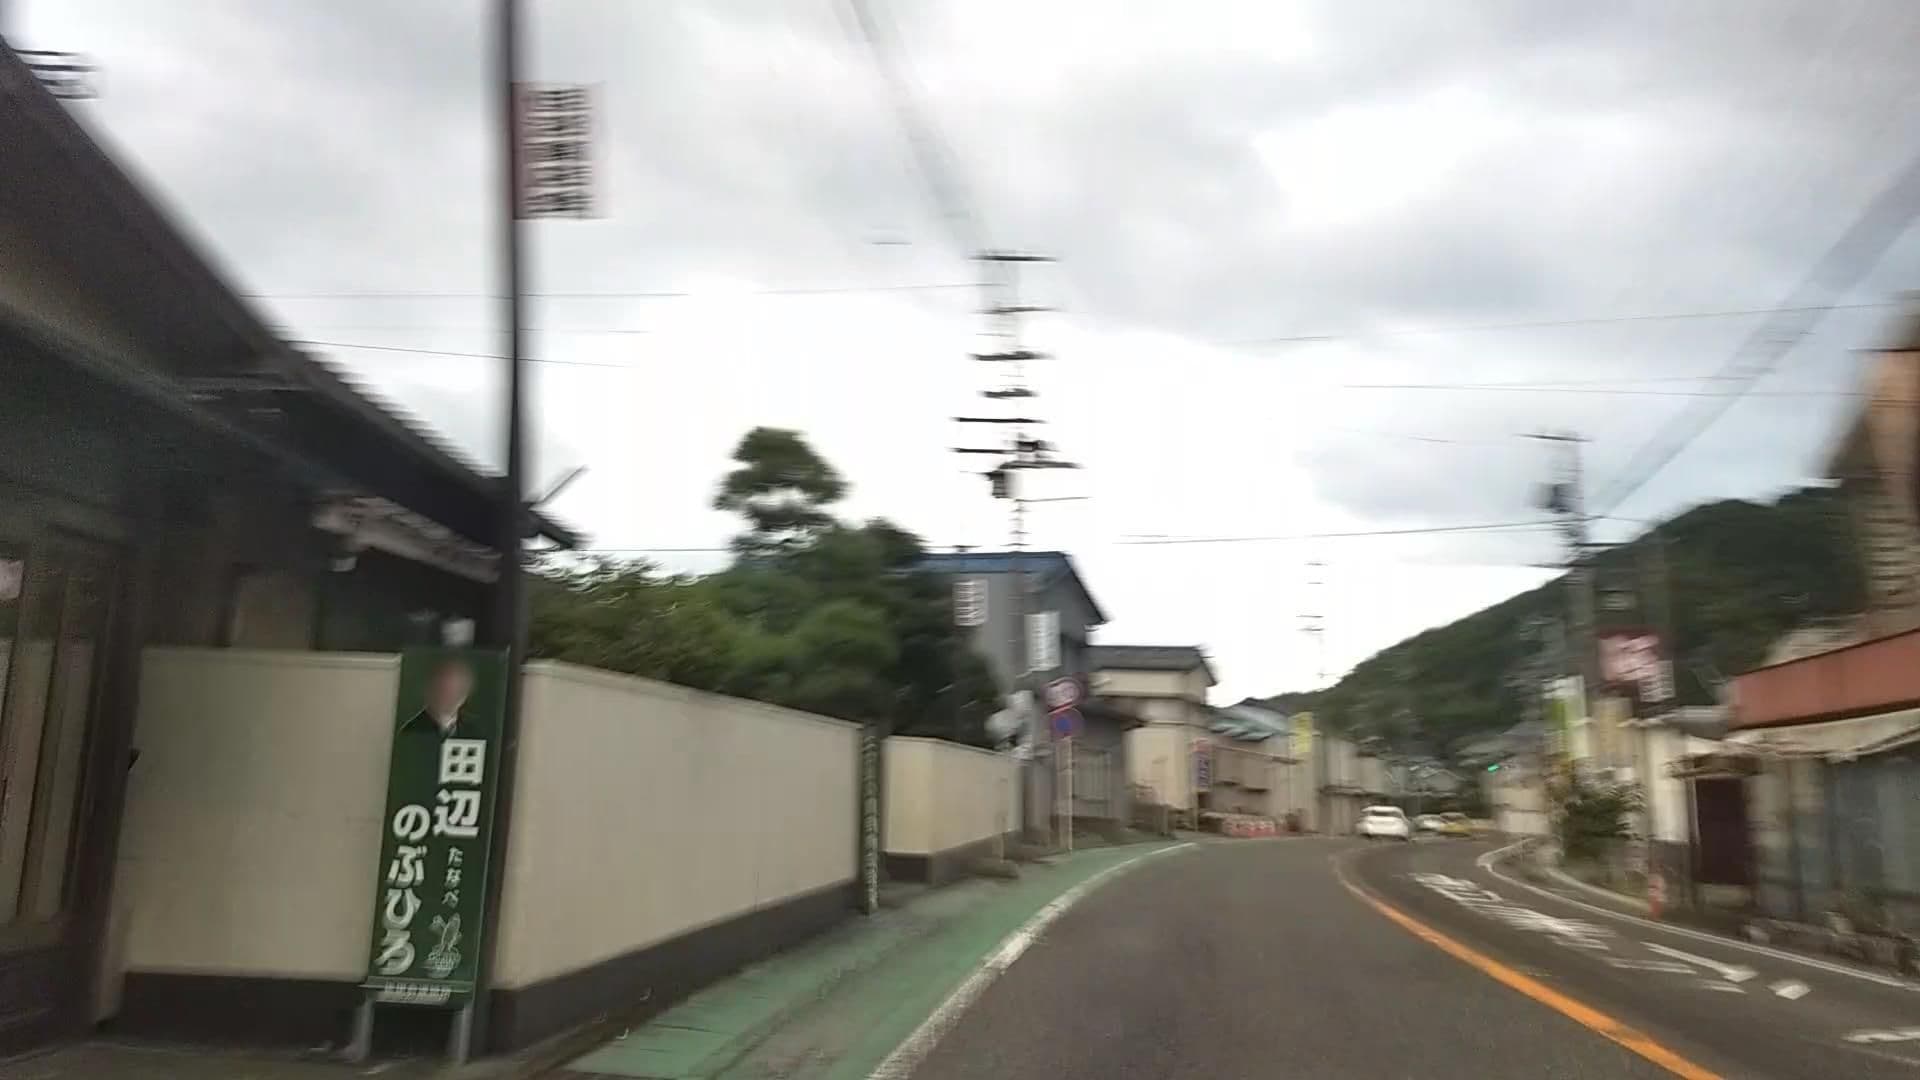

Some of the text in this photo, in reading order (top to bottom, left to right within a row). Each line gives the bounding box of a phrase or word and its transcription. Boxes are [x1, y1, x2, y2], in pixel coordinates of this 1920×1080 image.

[433, 738, 487, 837] 田辺
[375, 805, 430, 975] のぶひろ
[441, 847, 464, 909] たなべ
